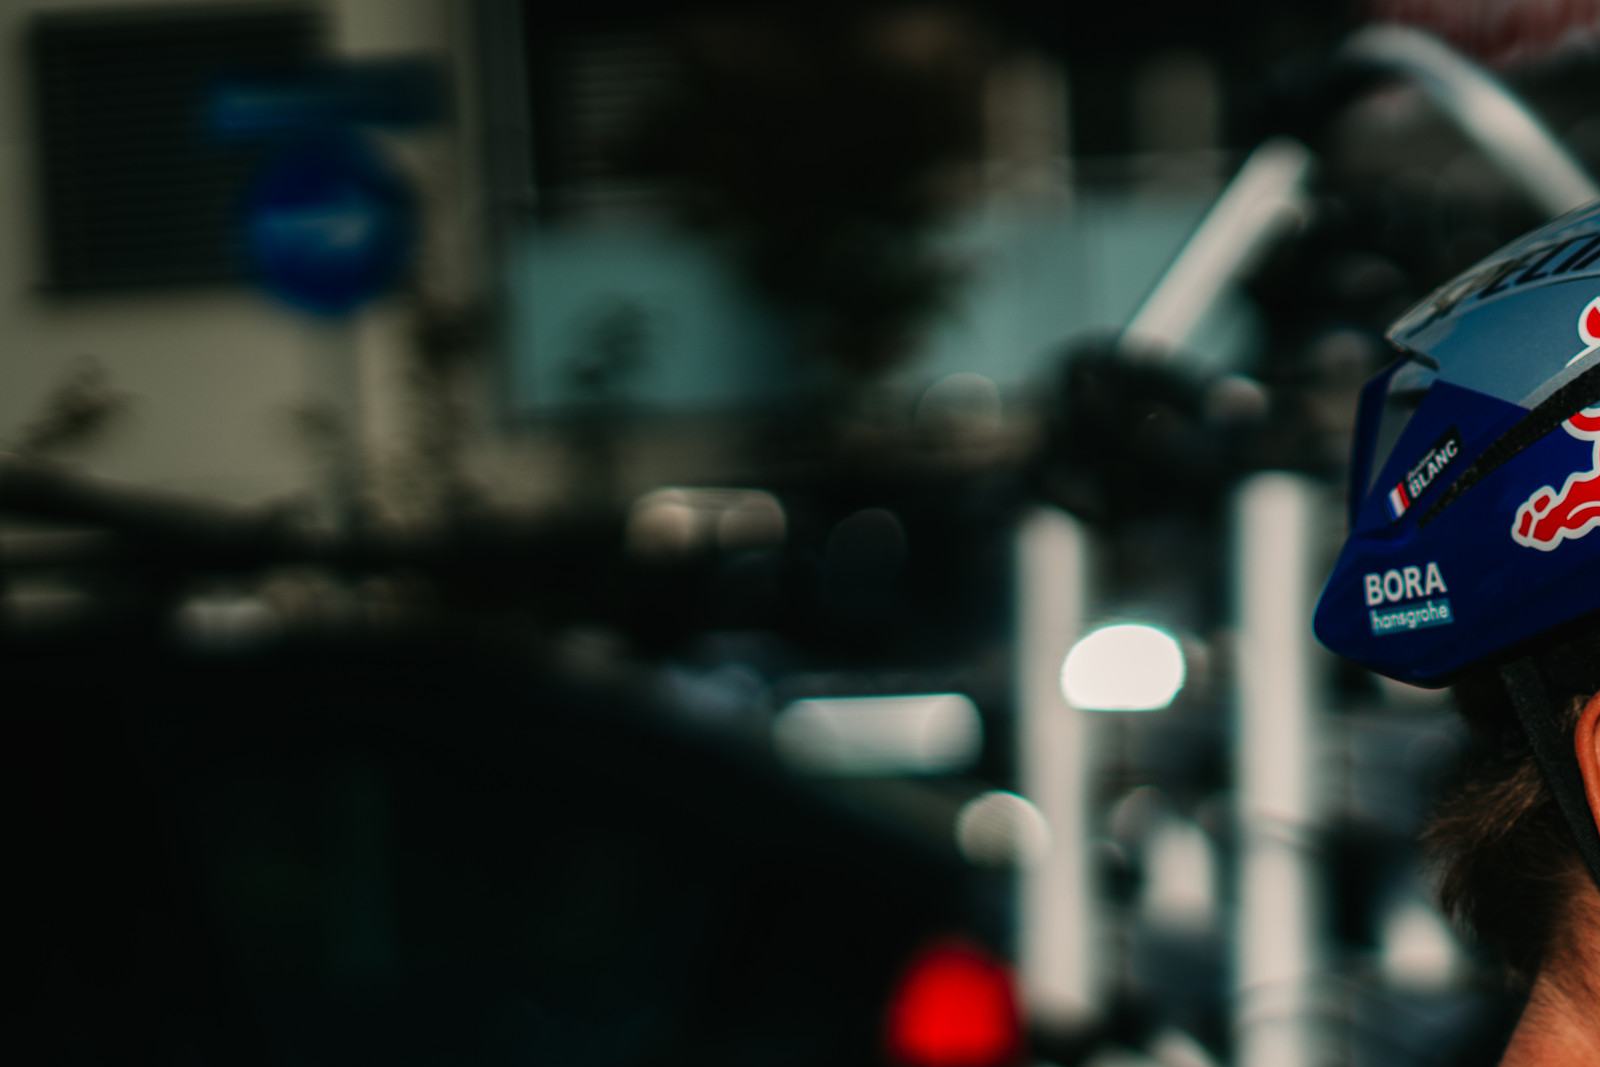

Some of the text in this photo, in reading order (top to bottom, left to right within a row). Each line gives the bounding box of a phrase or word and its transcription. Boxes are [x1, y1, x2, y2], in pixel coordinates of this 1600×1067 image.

[1408, 439, 1458, 498] BLANC
[1364, 562, 1448, 606] BORA
[1369, 600, 1450, 629] hansgrohe
